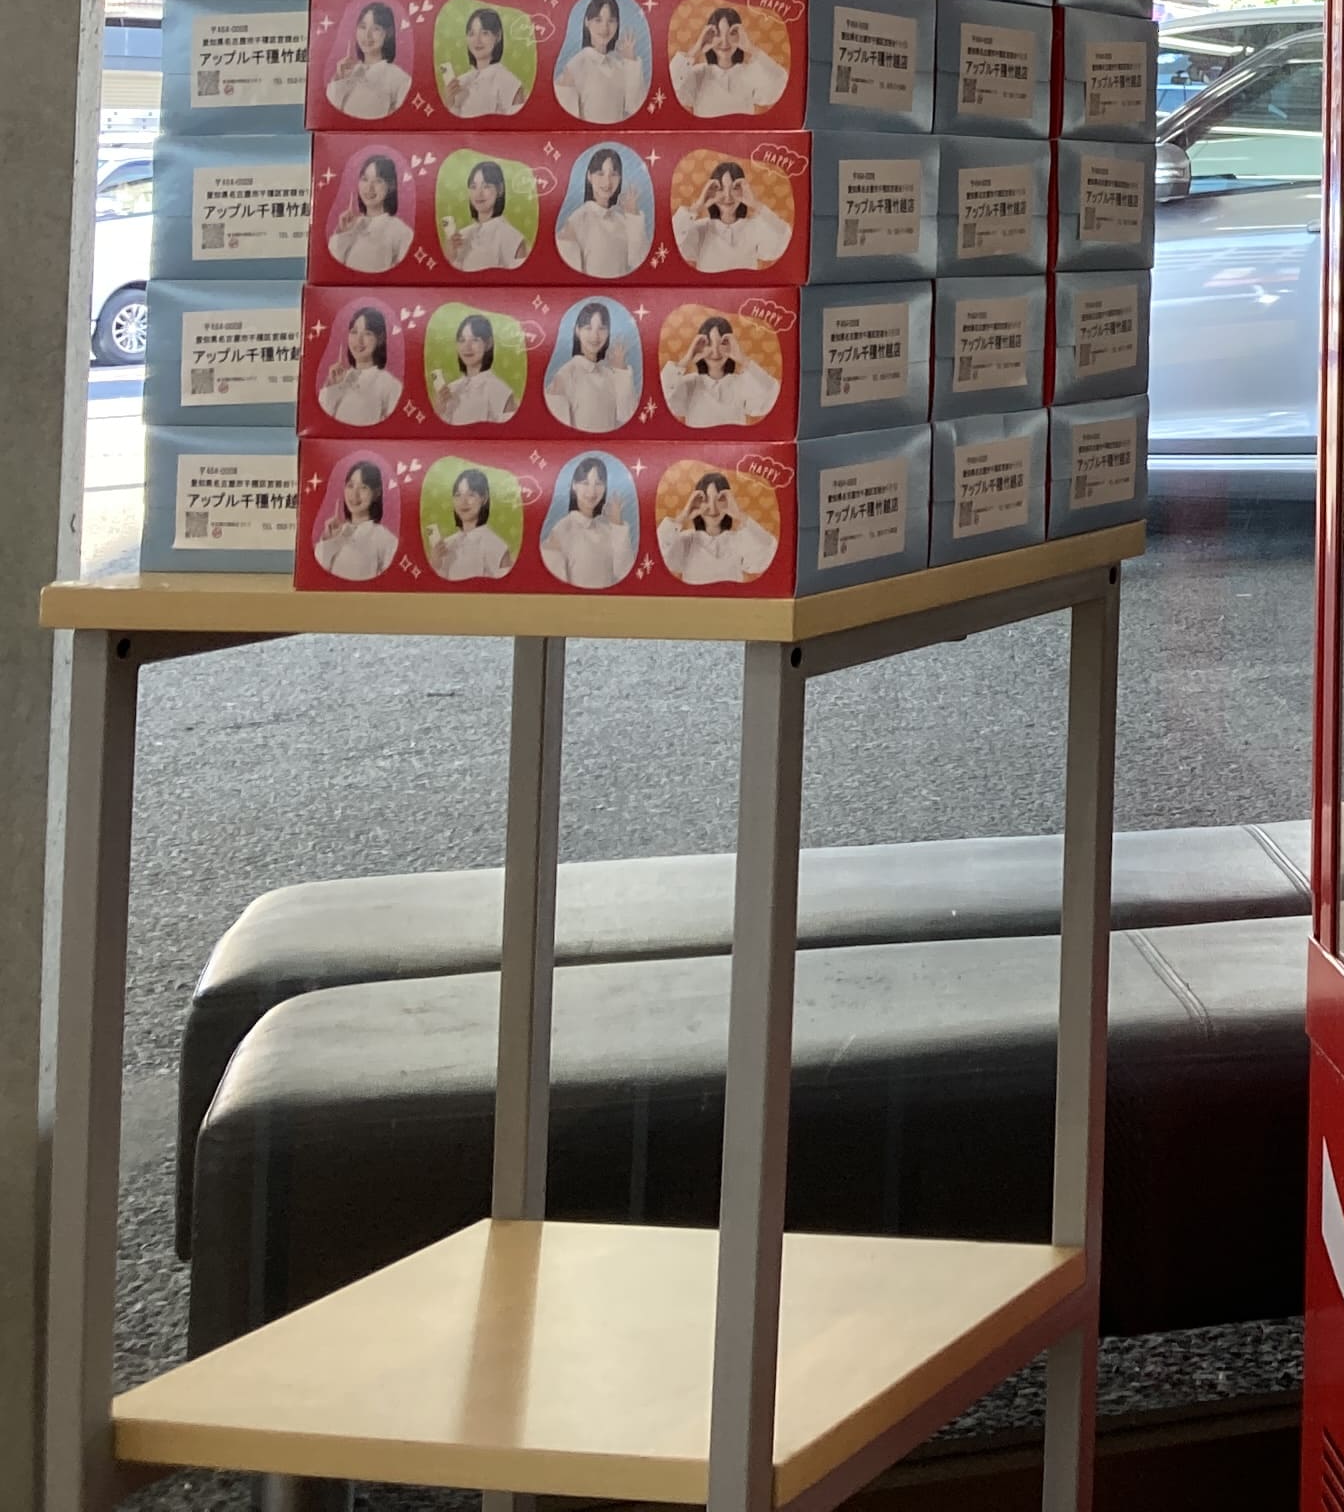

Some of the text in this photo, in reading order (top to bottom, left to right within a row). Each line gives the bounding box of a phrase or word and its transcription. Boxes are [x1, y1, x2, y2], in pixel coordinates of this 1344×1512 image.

[763, 151, 794, 171] HAPPY
[752, 306, 782, 326] HAPPY
[750, 461, 781, 481] HAPPY
